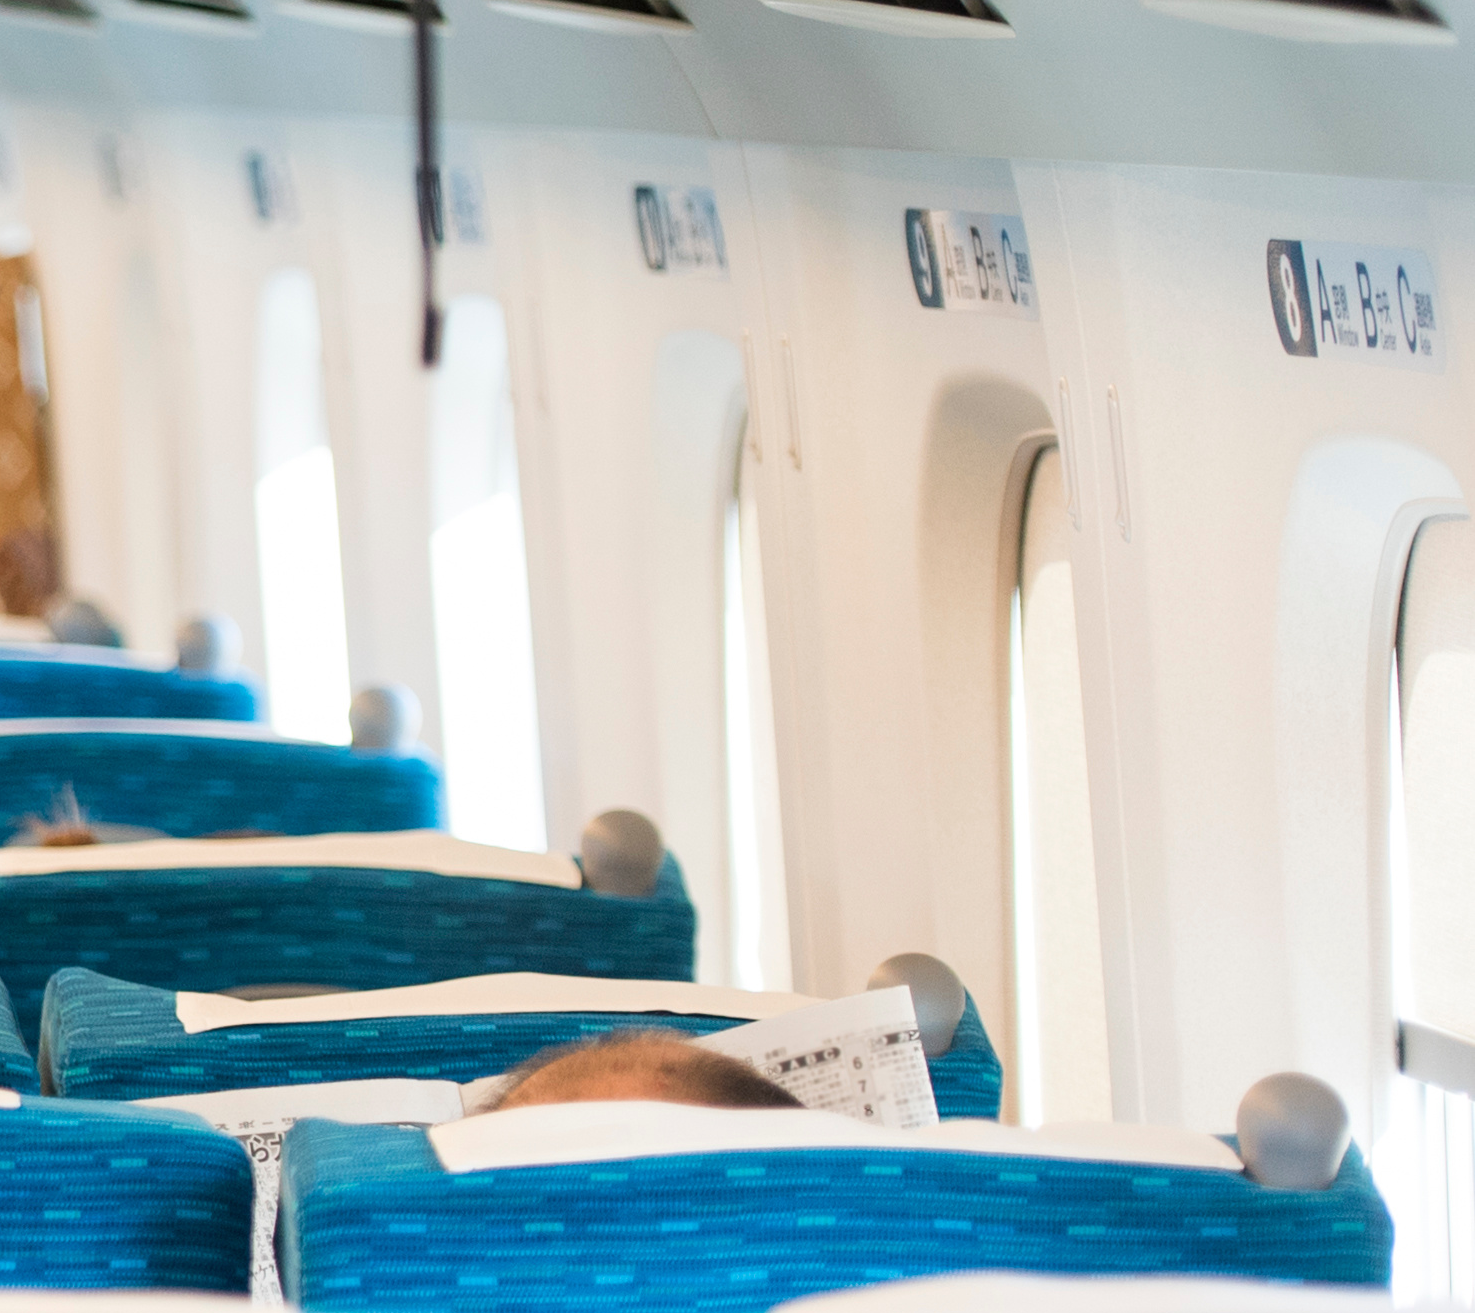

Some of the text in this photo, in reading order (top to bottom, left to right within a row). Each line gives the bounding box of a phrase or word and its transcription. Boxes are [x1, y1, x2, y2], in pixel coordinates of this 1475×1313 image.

[914, 218, 934, 298] 9
[941, 223, 961, 299] A
[970, 225, 989, 300] B
[1001, 228, 1018, 304] C
[1279, 253, 1303, 342] 8
[1316, 258, 1338, 345] A
[1355, 261, 1378, 348] B
[1396, 264, 1417, 355] C
[852, 1056, 863, 1070] 6
[858, 1079, 866, 1093] 7
[864, 1103, 874, 1117] 8
